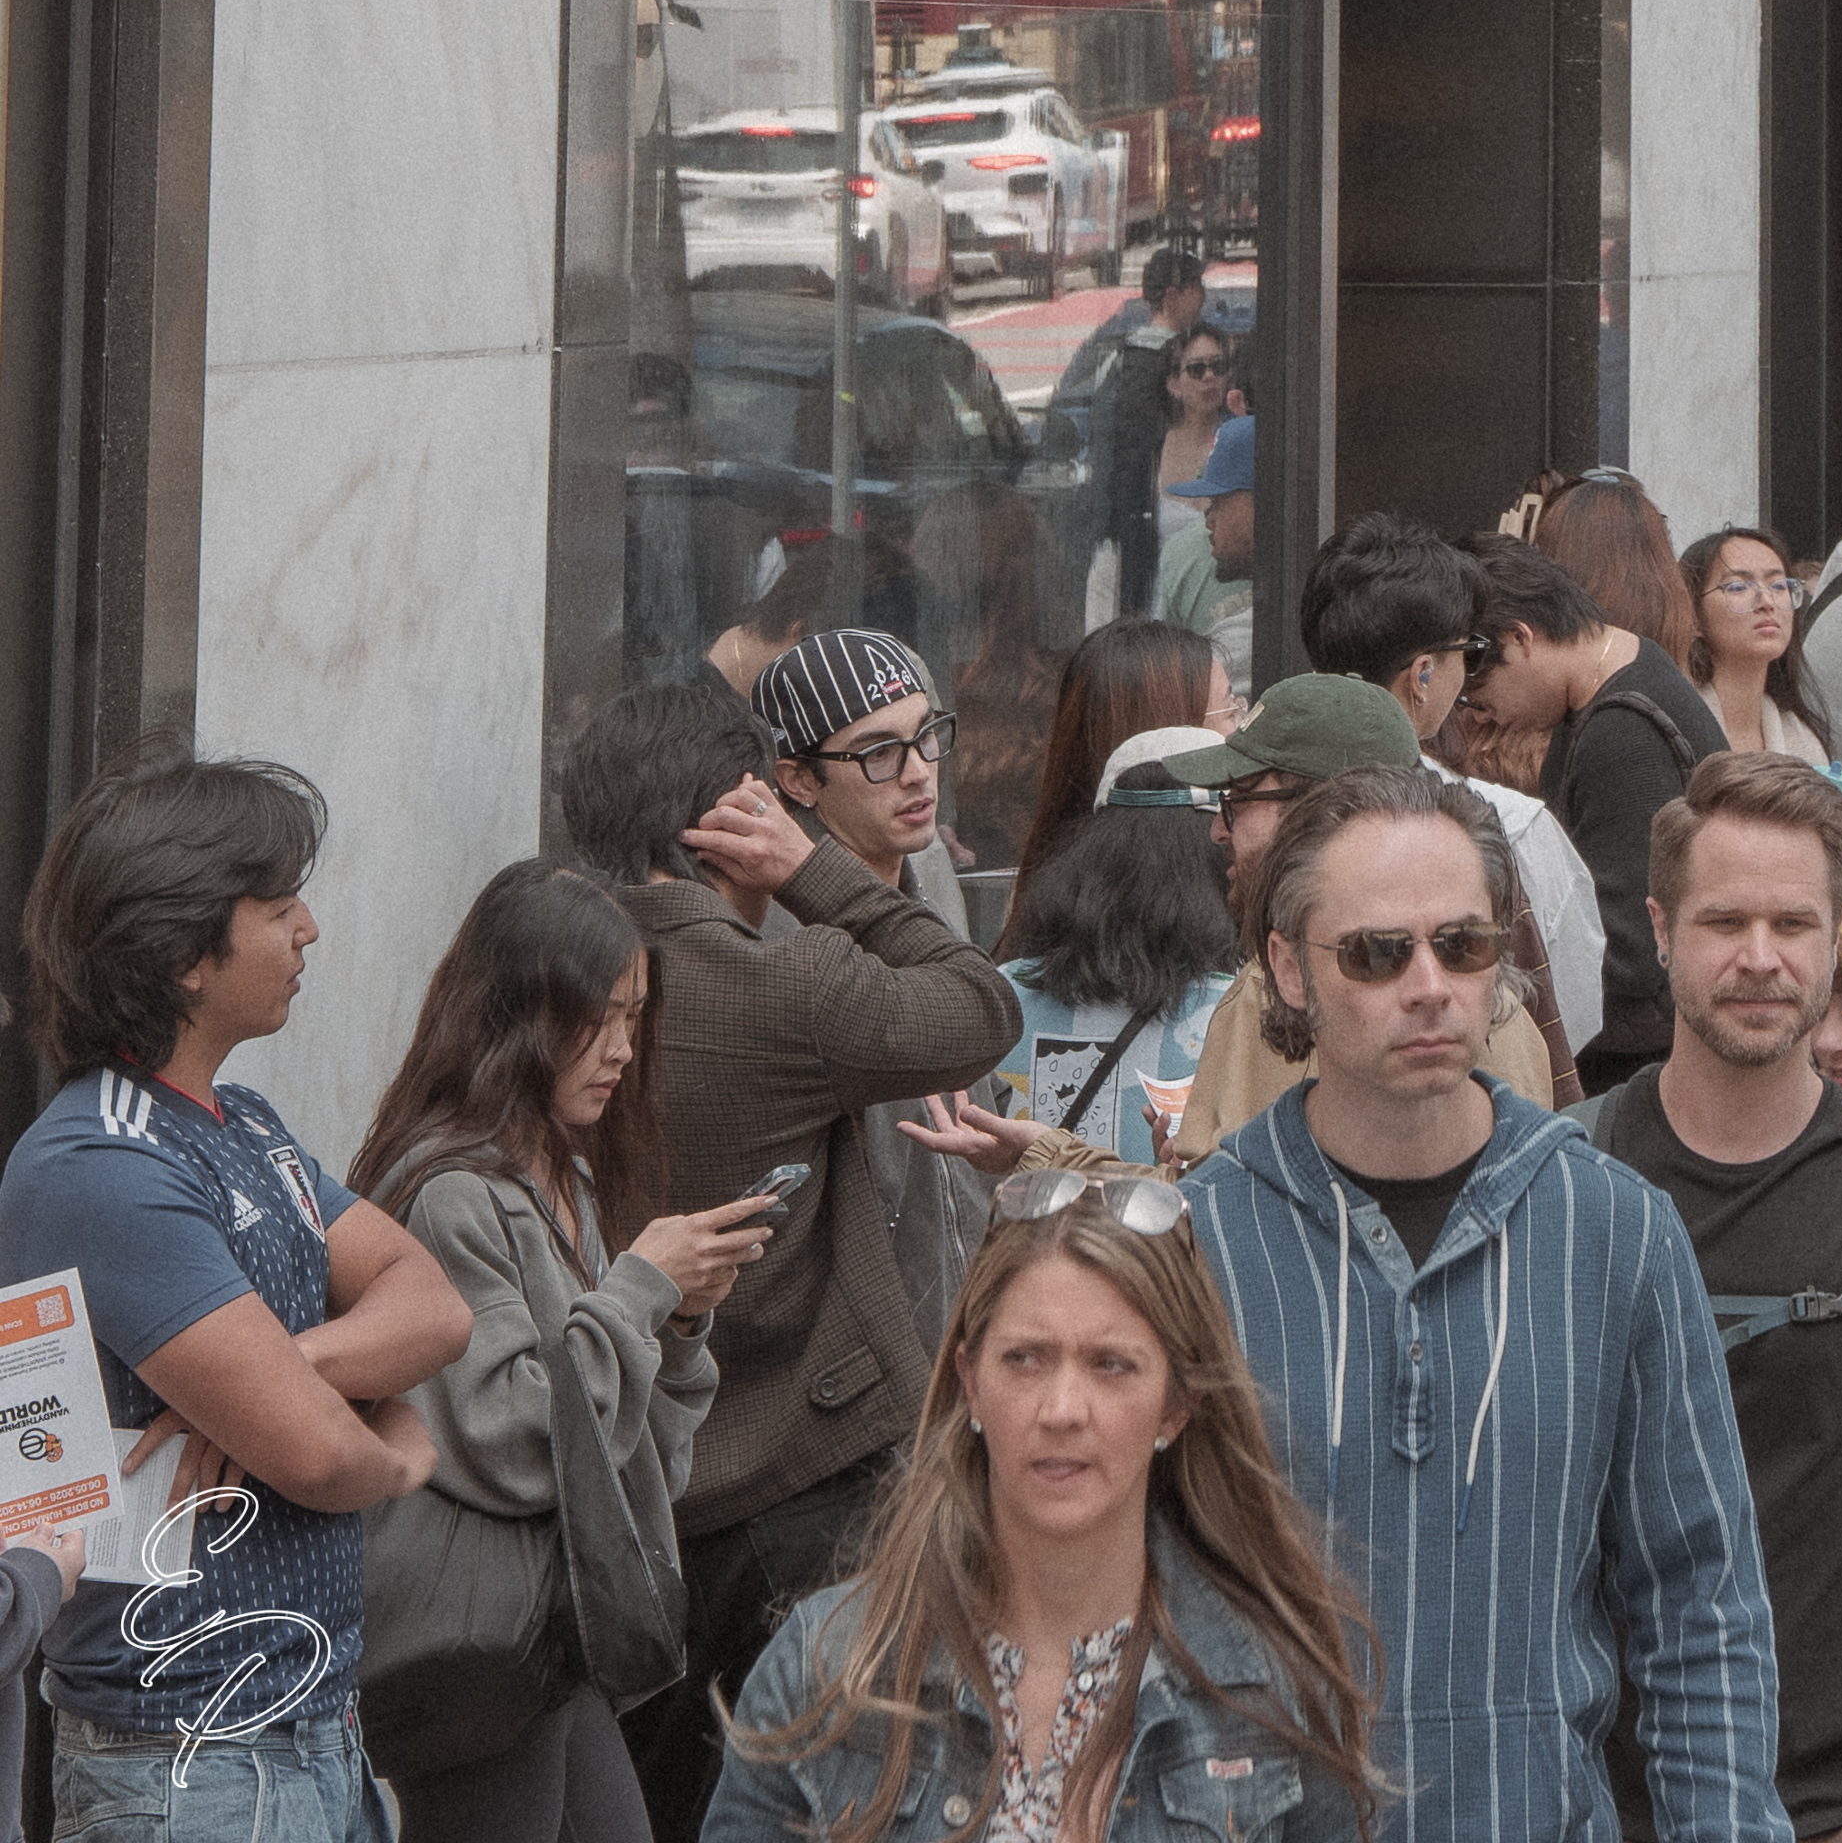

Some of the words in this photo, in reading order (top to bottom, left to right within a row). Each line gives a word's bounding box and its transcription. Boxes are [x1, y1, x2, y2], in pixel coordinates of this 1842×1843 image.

[866, 664, 912, 701] 2026
[233, 1207, 263, 1232] adidas
[0, 1395, 62, 1424] WORLD
[50, 1479, 101, 1502] 06.05.2026
[0, 1496, 42, 1517] 06.14.20
[89, 1497, 104, 1509] NO
[22, 1509, 63, 1529] HUMANS
